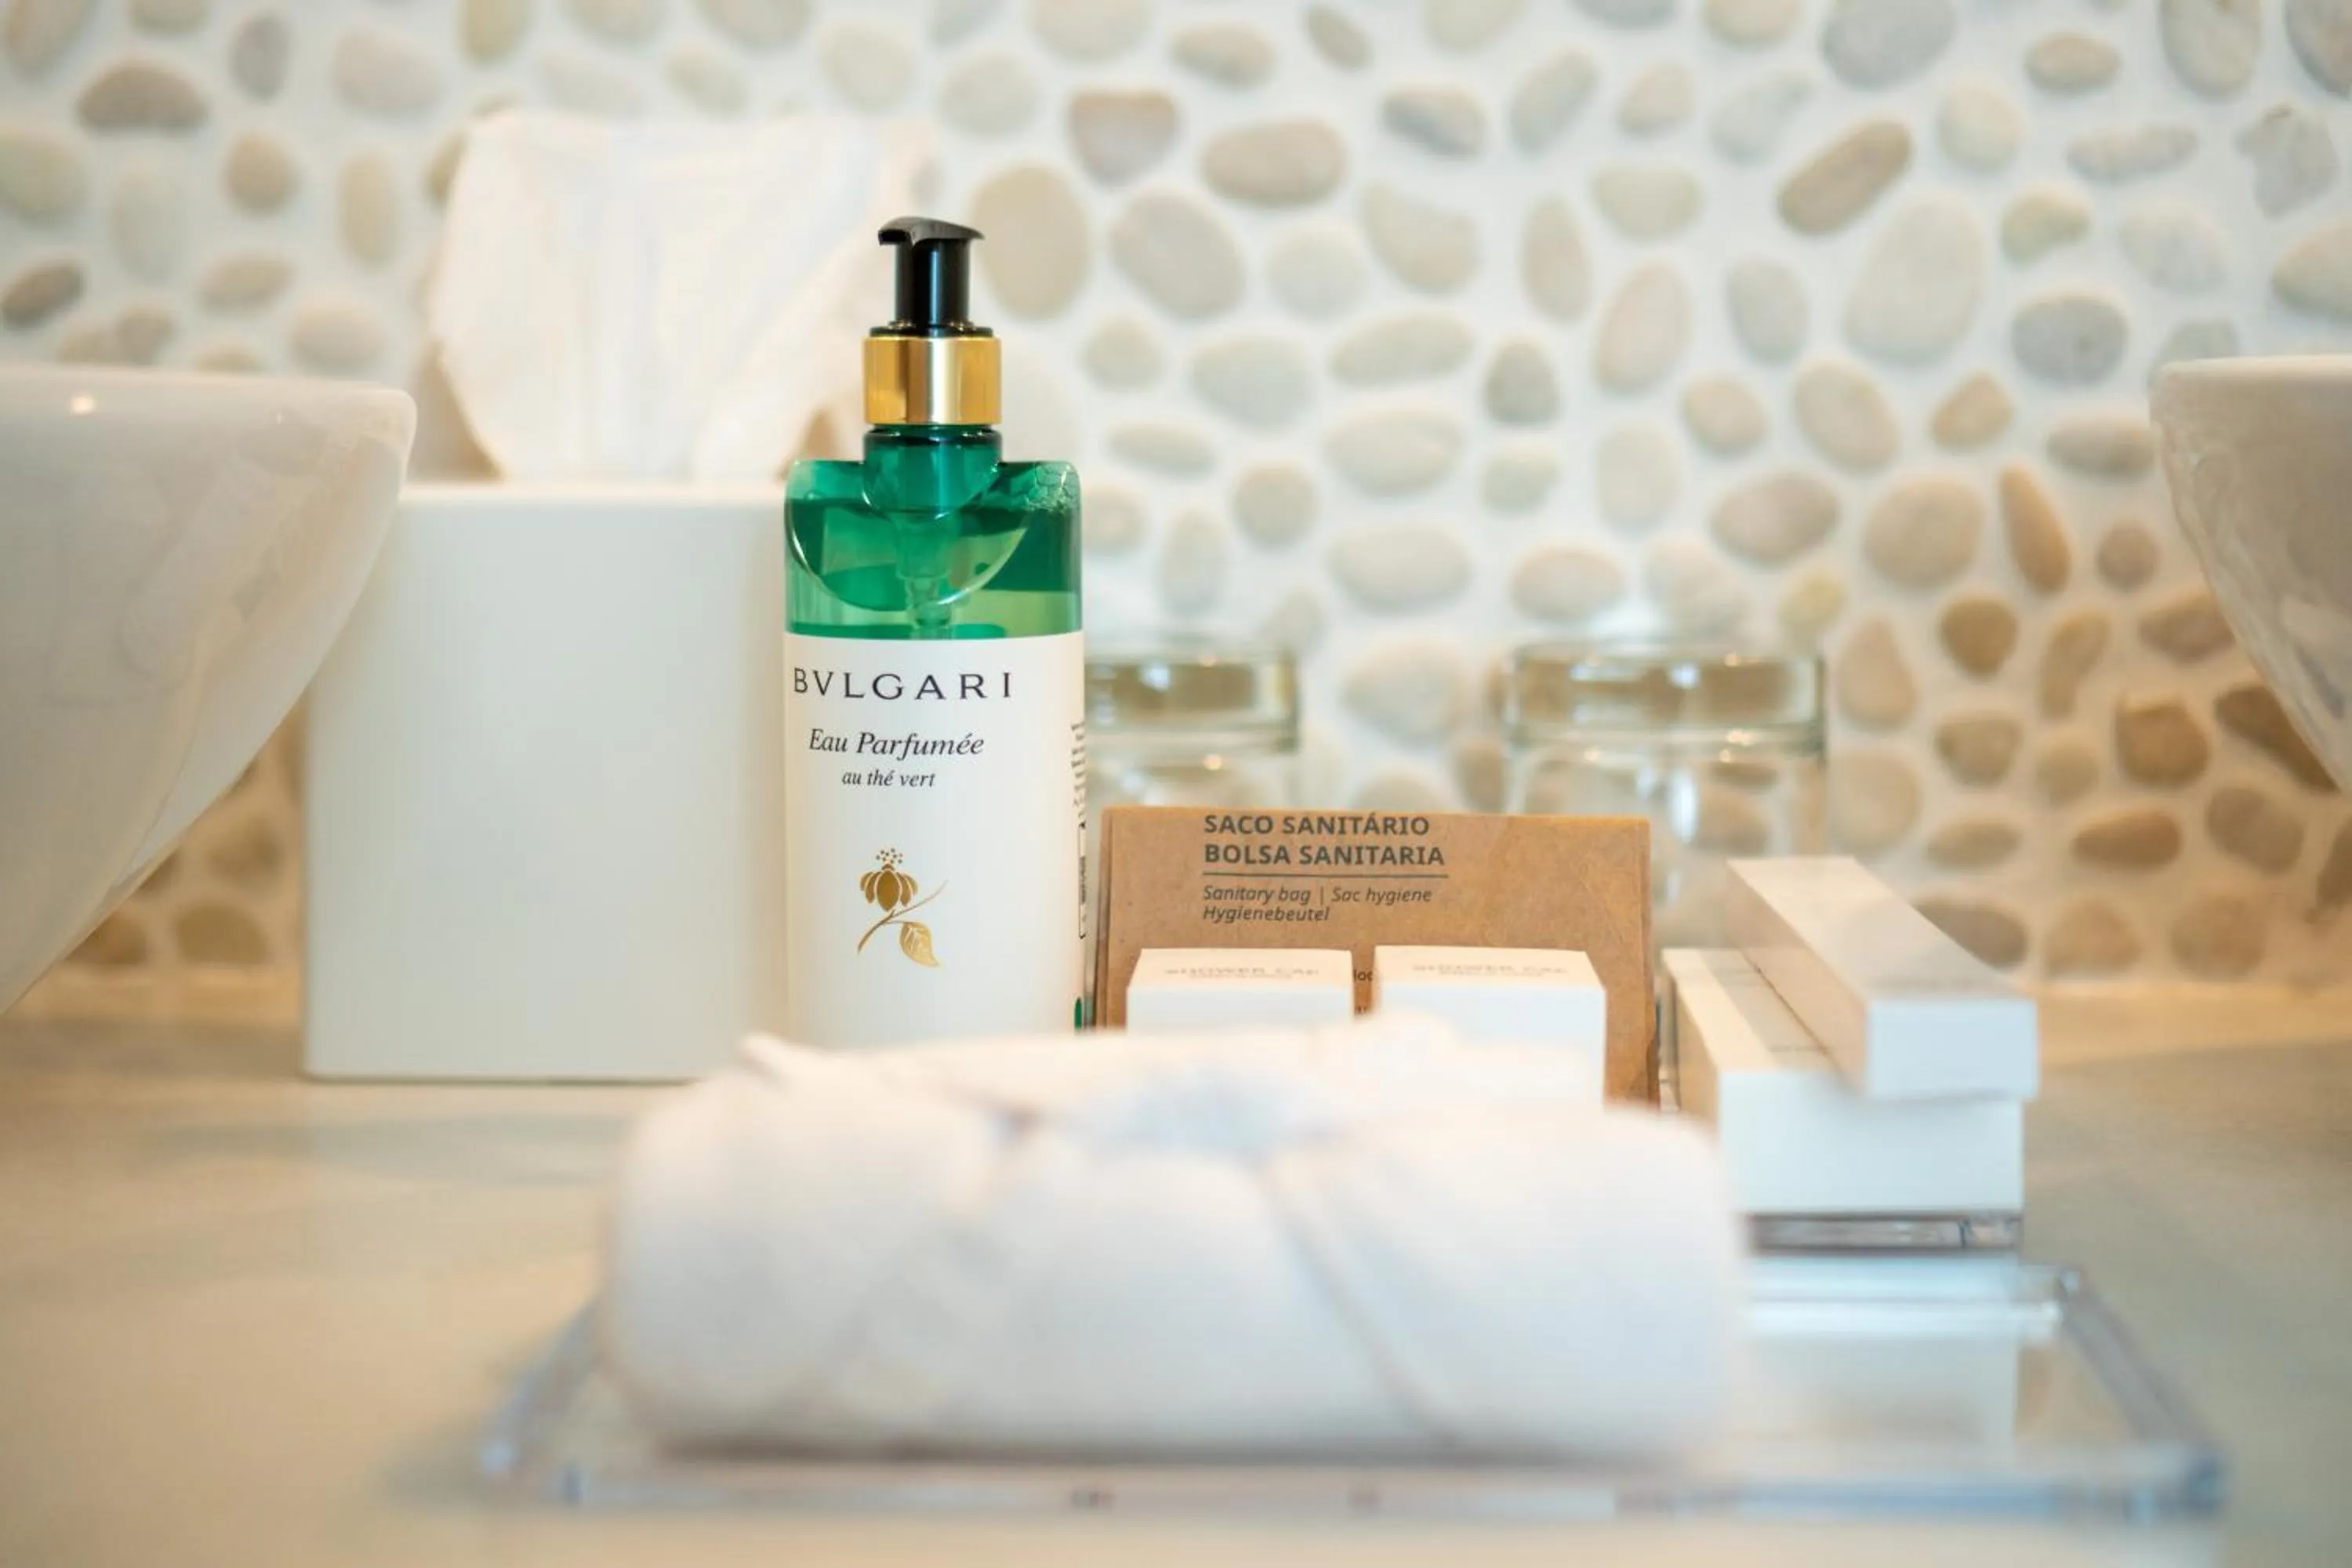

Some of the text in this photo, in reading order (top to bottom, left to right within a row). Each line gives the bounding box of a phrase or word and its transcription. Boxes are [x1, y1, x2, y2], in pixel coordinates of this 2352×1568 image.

[793, 668, 1011, 700] BVLGARI
[809, 728, 985, 761] Eau Parfumée
[842, 769, 936, 787] au thé vert
[1203, 812, 1430, 836] SACO SANITÁRIO
[1204, 844, 1445, 866] BOLSA SANITARIA
[1203, 885, 1432, 905] Sanitary bag Sac hygiene
[1203, 906, 1330, 924] Hygienebeutel
